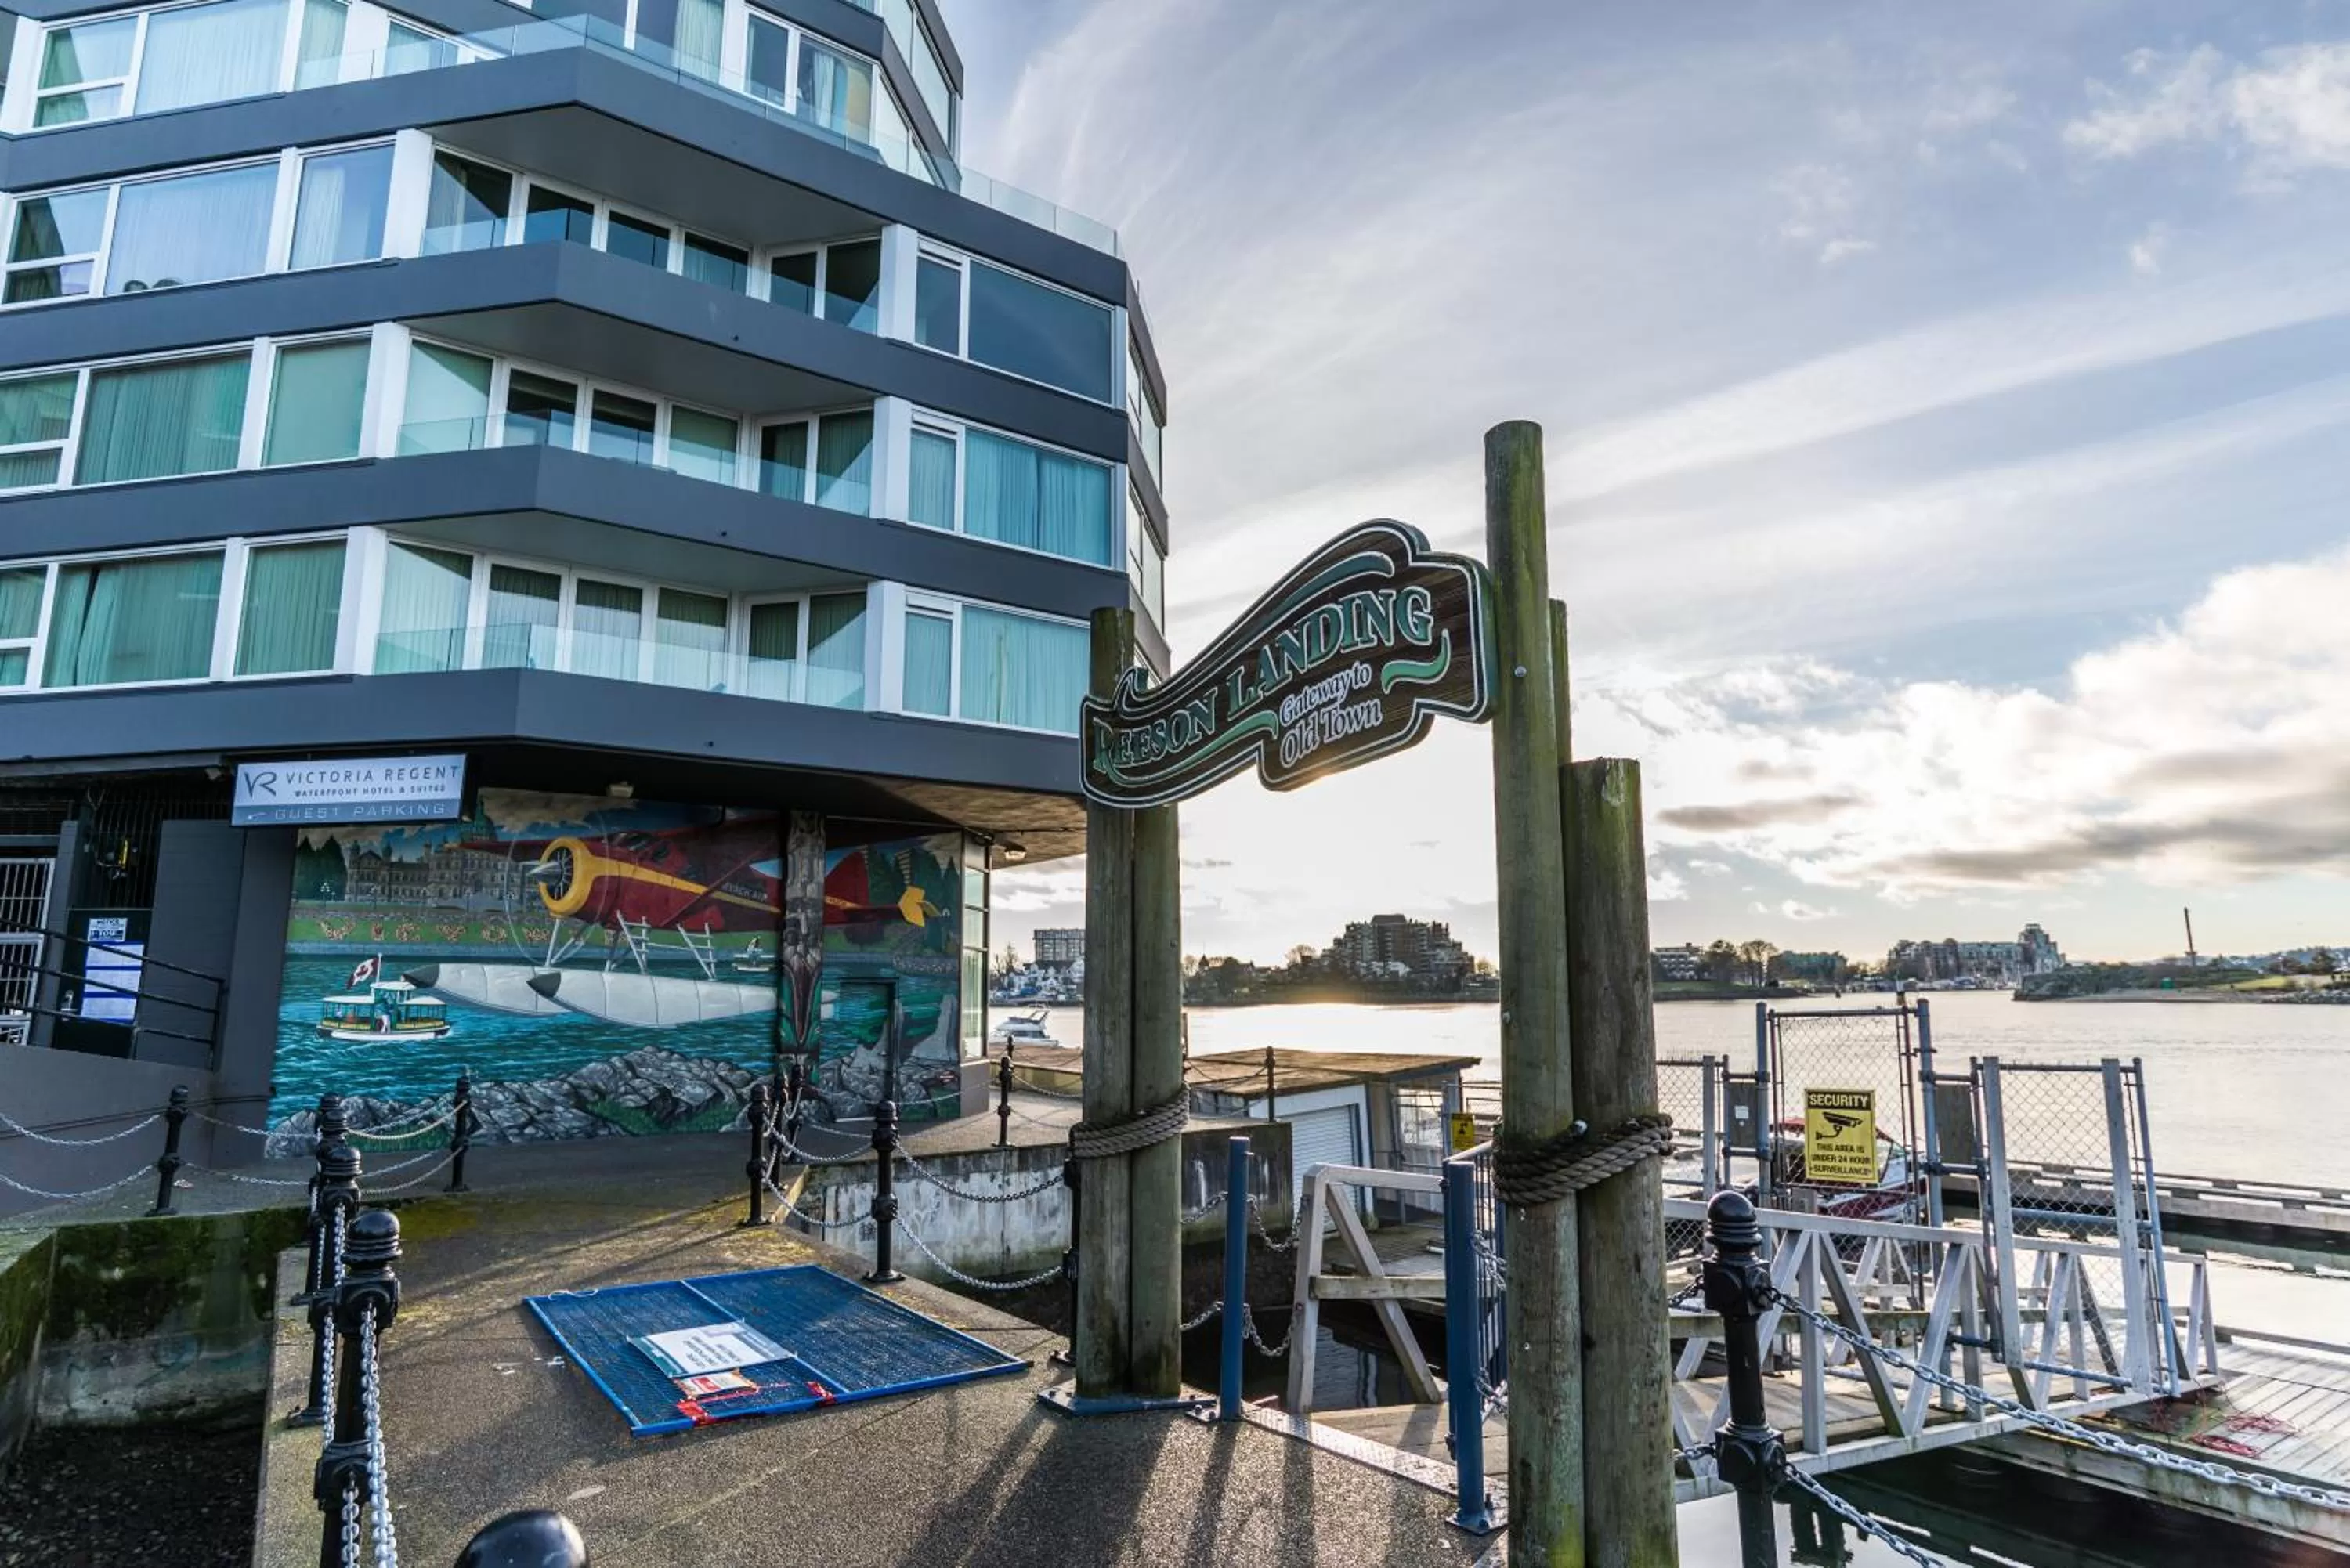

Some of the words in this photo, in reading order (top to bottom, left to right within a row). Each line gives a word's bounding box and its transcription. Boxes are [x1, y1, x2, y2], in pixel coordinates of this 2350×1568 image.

[1093, 687, 1218, 774] REESON
[1226, 586, 1434, 721] LANDING
[1280, 671, 1353, 727] Gateway
[1352, 660, 1372, 690] to
[1279, 711, 1321, 768] Old
[1321, 699, 1383, 742] Town
[285, 770, 374, 784] VICTORIA
[385, 765, 461, 782] REGENT
[294, 787, 359, 798] WATERFRONT
[363, 786, 394, 795] HOTEL
[410, 784, 446, 793] SUITES
[275, 807, 340, 820] GUEST
[354, 802, 446, 816] PARKING
[1810, 1094, 1868, 1107] SECURITY
